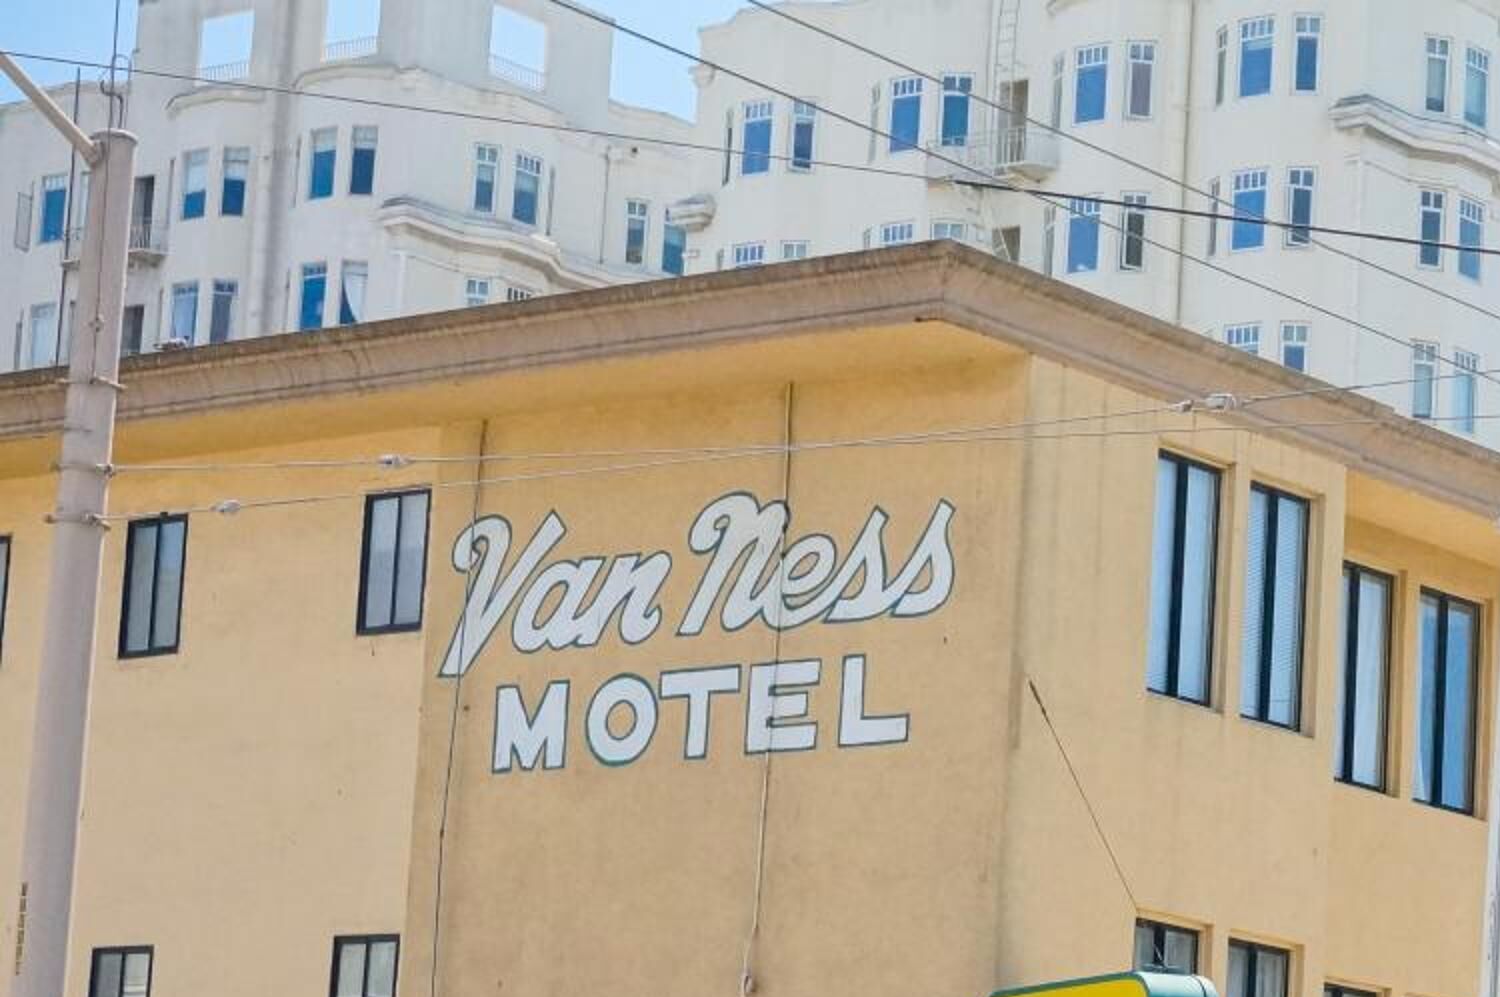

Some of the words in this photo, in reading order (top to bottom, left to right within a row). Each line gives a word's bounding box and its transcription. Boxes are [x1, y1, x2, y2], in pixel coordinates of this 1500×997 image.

[438, 509, 672, 677] Van
[676, 490, 956, 634] Ness
[491, 654, 909, 774] MOTEL
